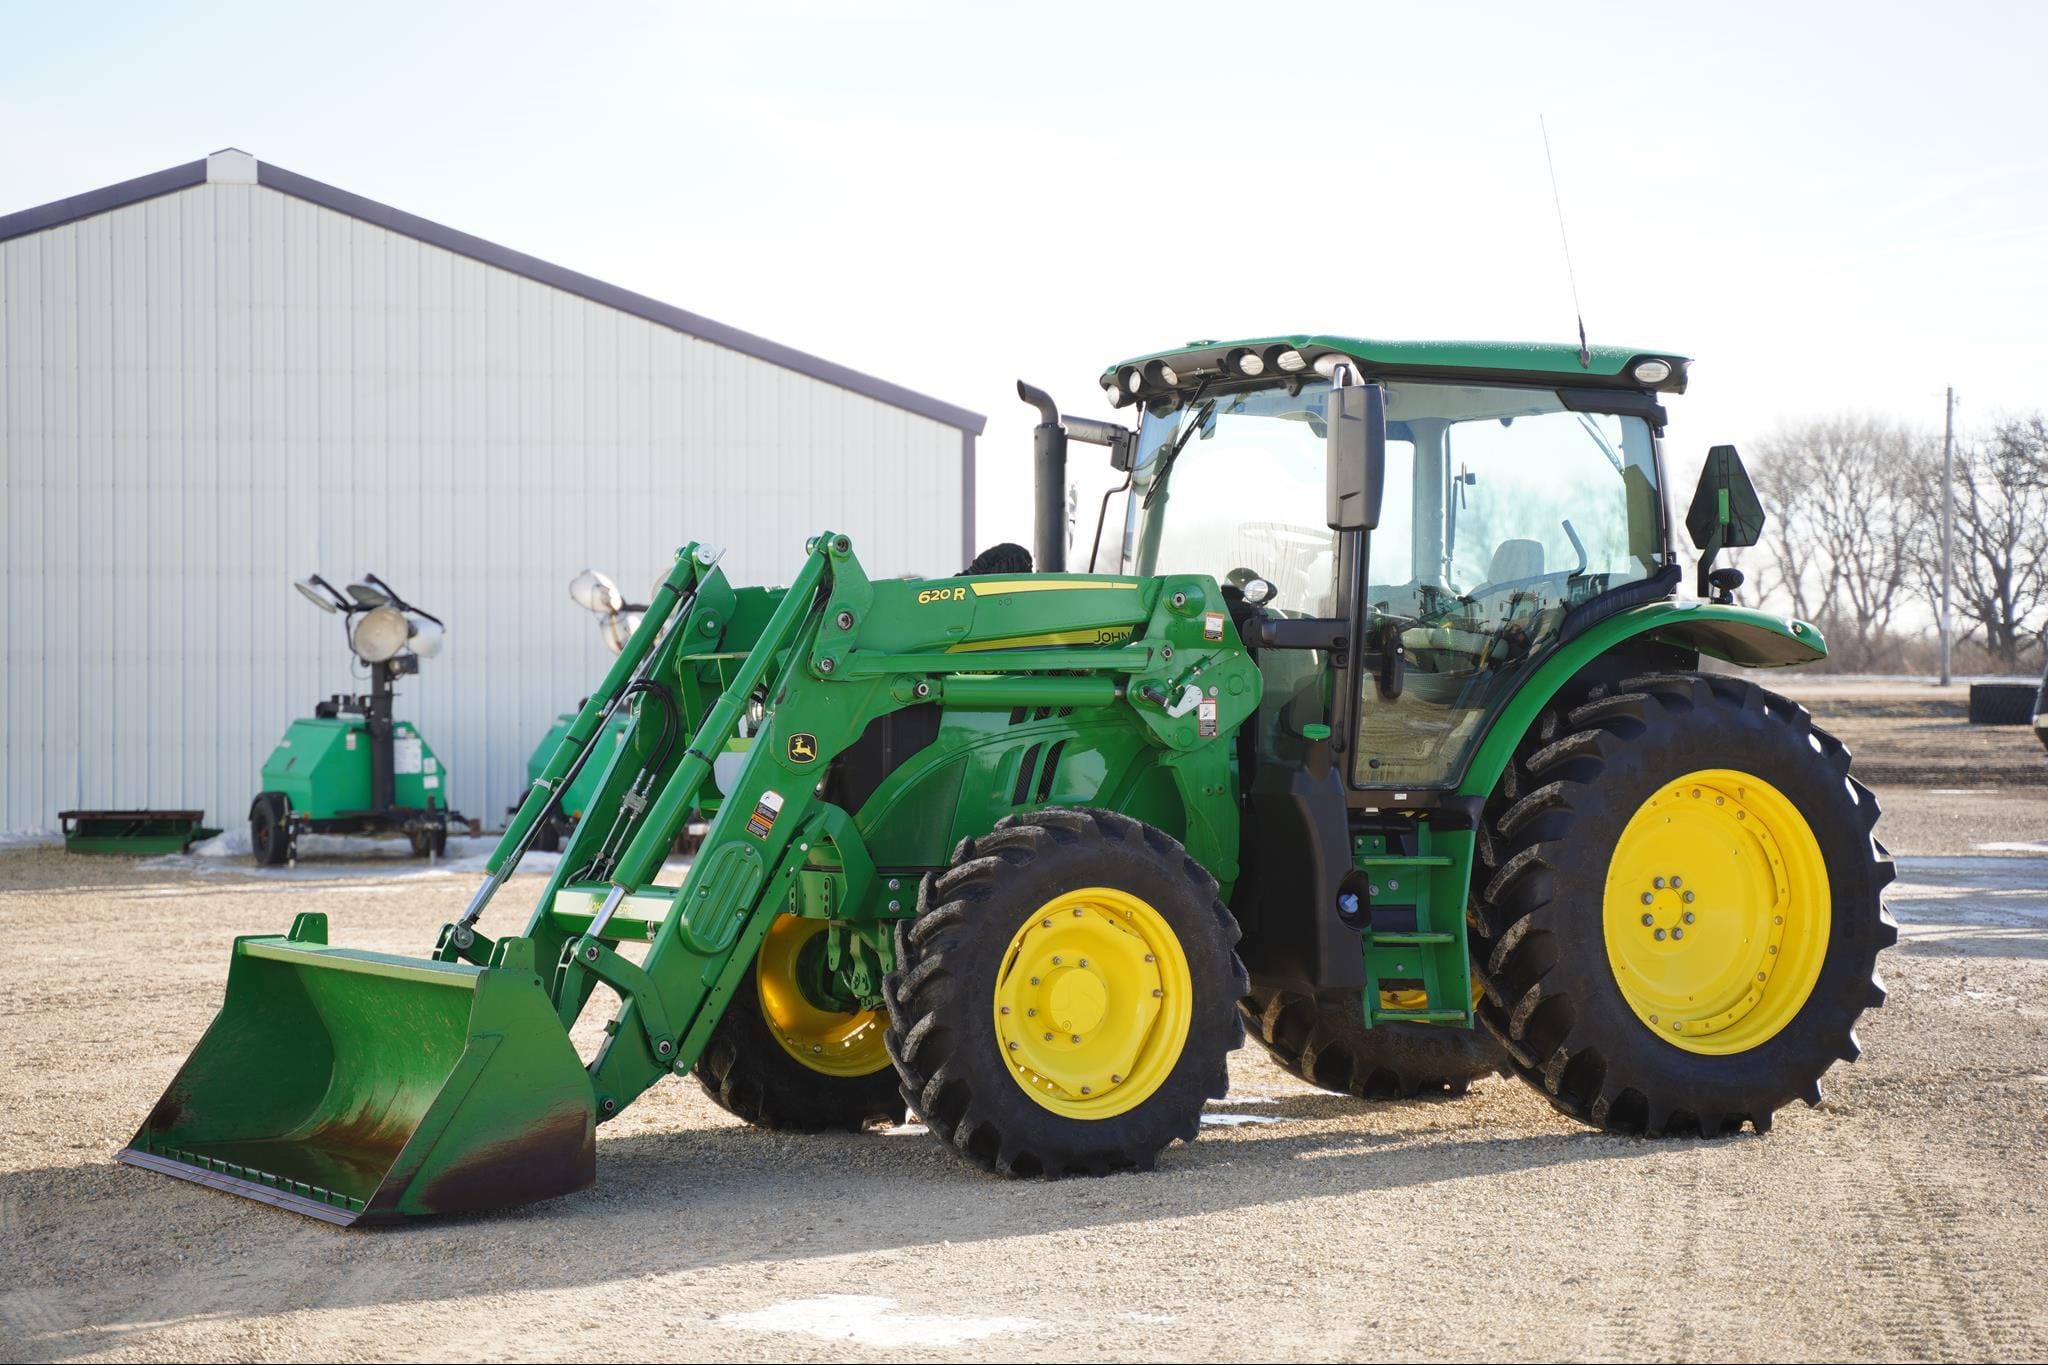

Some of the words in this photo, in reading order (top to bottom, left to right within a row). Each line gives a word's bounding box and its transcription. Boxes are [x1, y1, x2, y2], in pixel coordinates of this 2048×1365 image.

[918, 588, 951, 604] 620
[953, 587, 966, 601] R
[1094, 630, 1130, 643] JOHN
